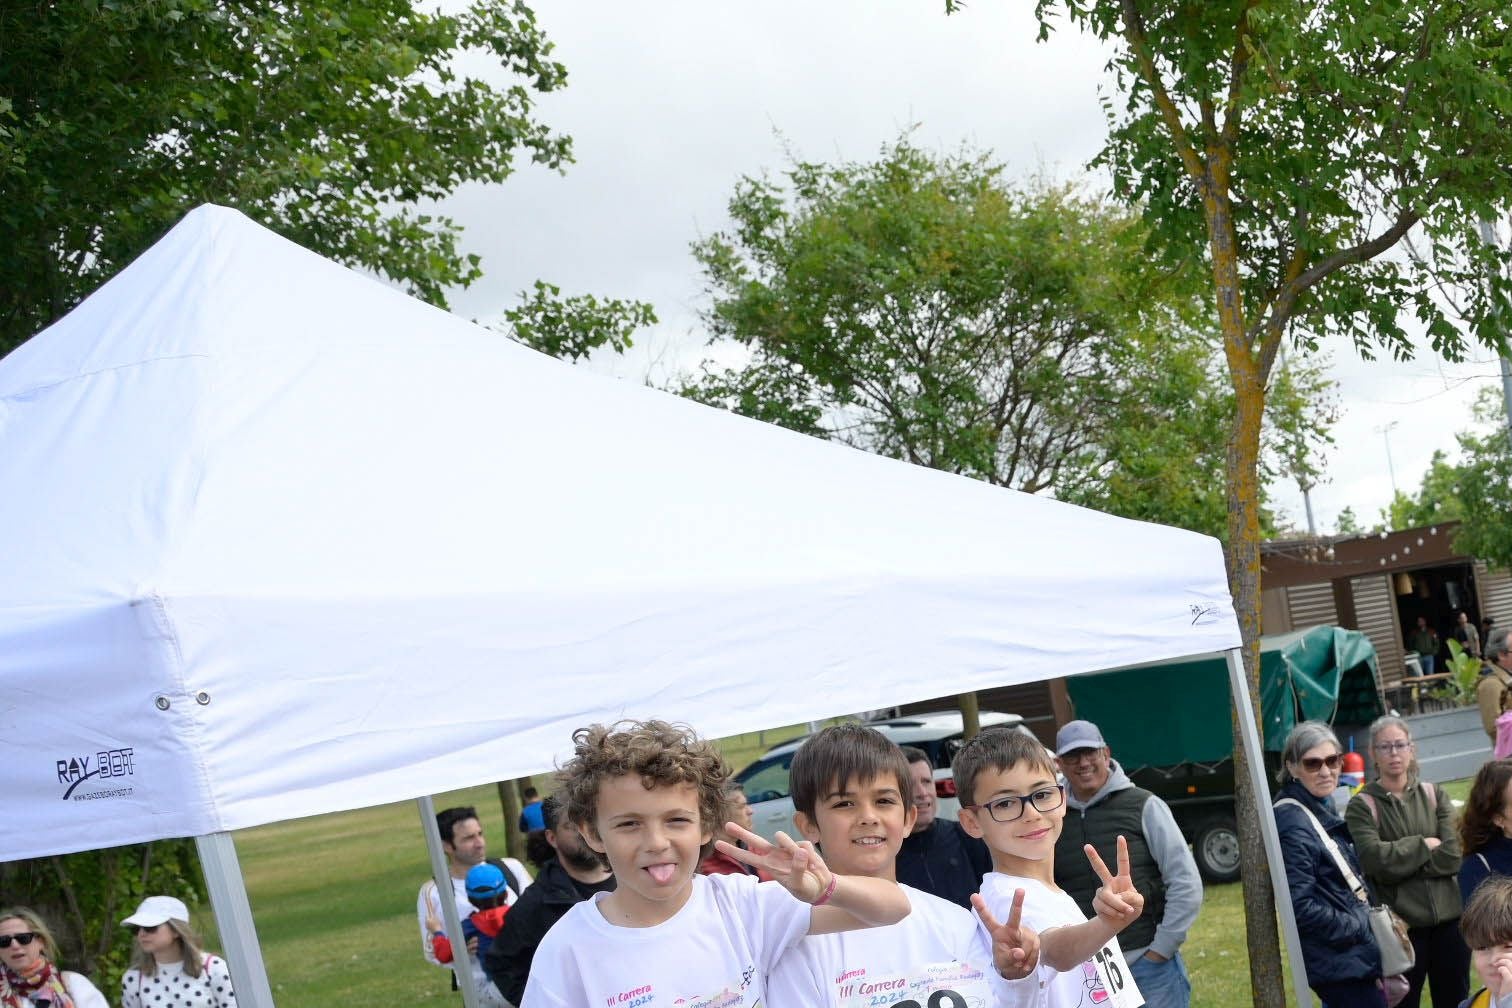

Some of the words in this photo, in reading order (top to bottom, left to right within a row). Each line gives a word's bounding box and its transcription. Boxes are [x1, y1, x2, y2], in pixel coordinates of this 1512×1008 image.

[56, 756, 90, 784] RAY
[97, 748, 134, 779] BOT
[618, 984, 652, 1002] Carrera
[859, 978, 905, 994] Carrera
